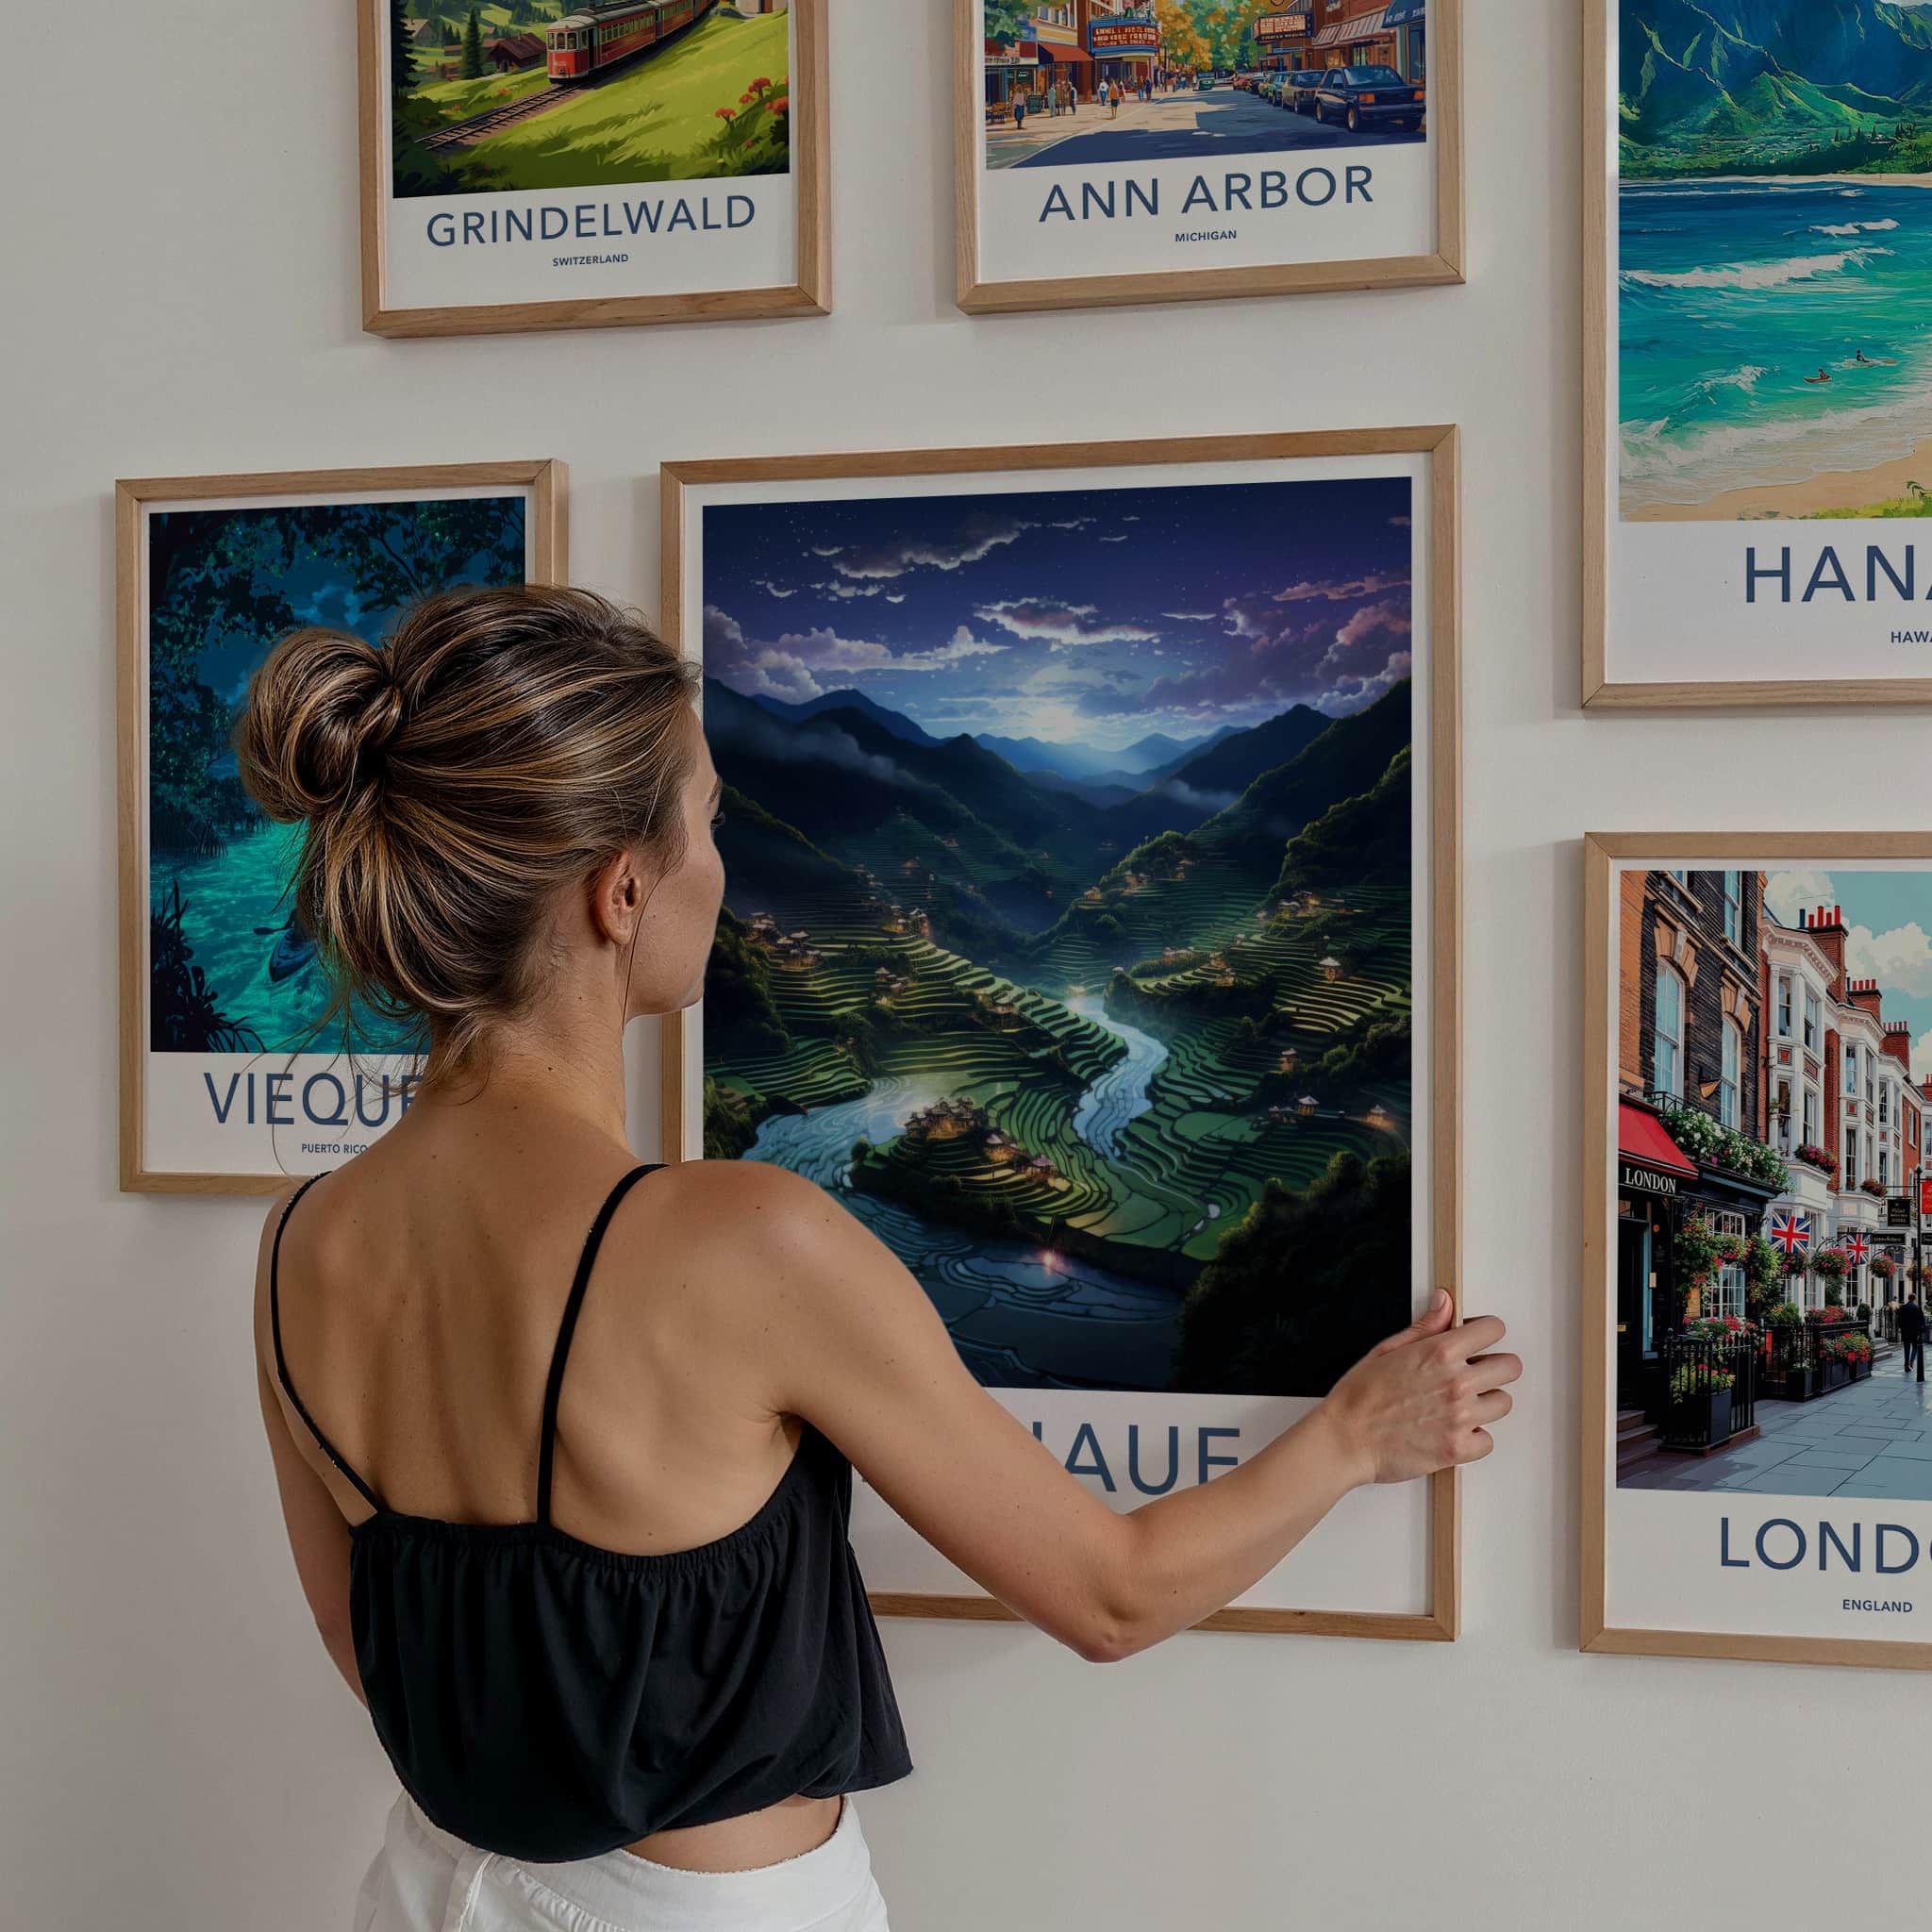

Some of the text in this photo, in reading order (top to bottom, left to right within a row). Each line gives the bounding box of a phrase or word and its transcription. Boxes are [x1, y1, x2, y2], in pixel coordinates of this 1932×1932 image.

[1039, 165, 1374, 223] ANN ARBOR
[426, 194, 756, 247] GRINDELWALD
[1174, 230, 1238, 242] MICHIGAN
[552, 254, 629, 267] SWITZERLAND
[1745, 544, 1932, 603] HAN
[1890, 631, 1932, 643] HAW
[301, 1143, 368, 1155] PUERTO RICO
[1624, 1167, 1677, 1194] LONDON
[1721, 1516, 1932, 1574] LOND
[1842, 1599, 1913, 1613] ENGLAND
